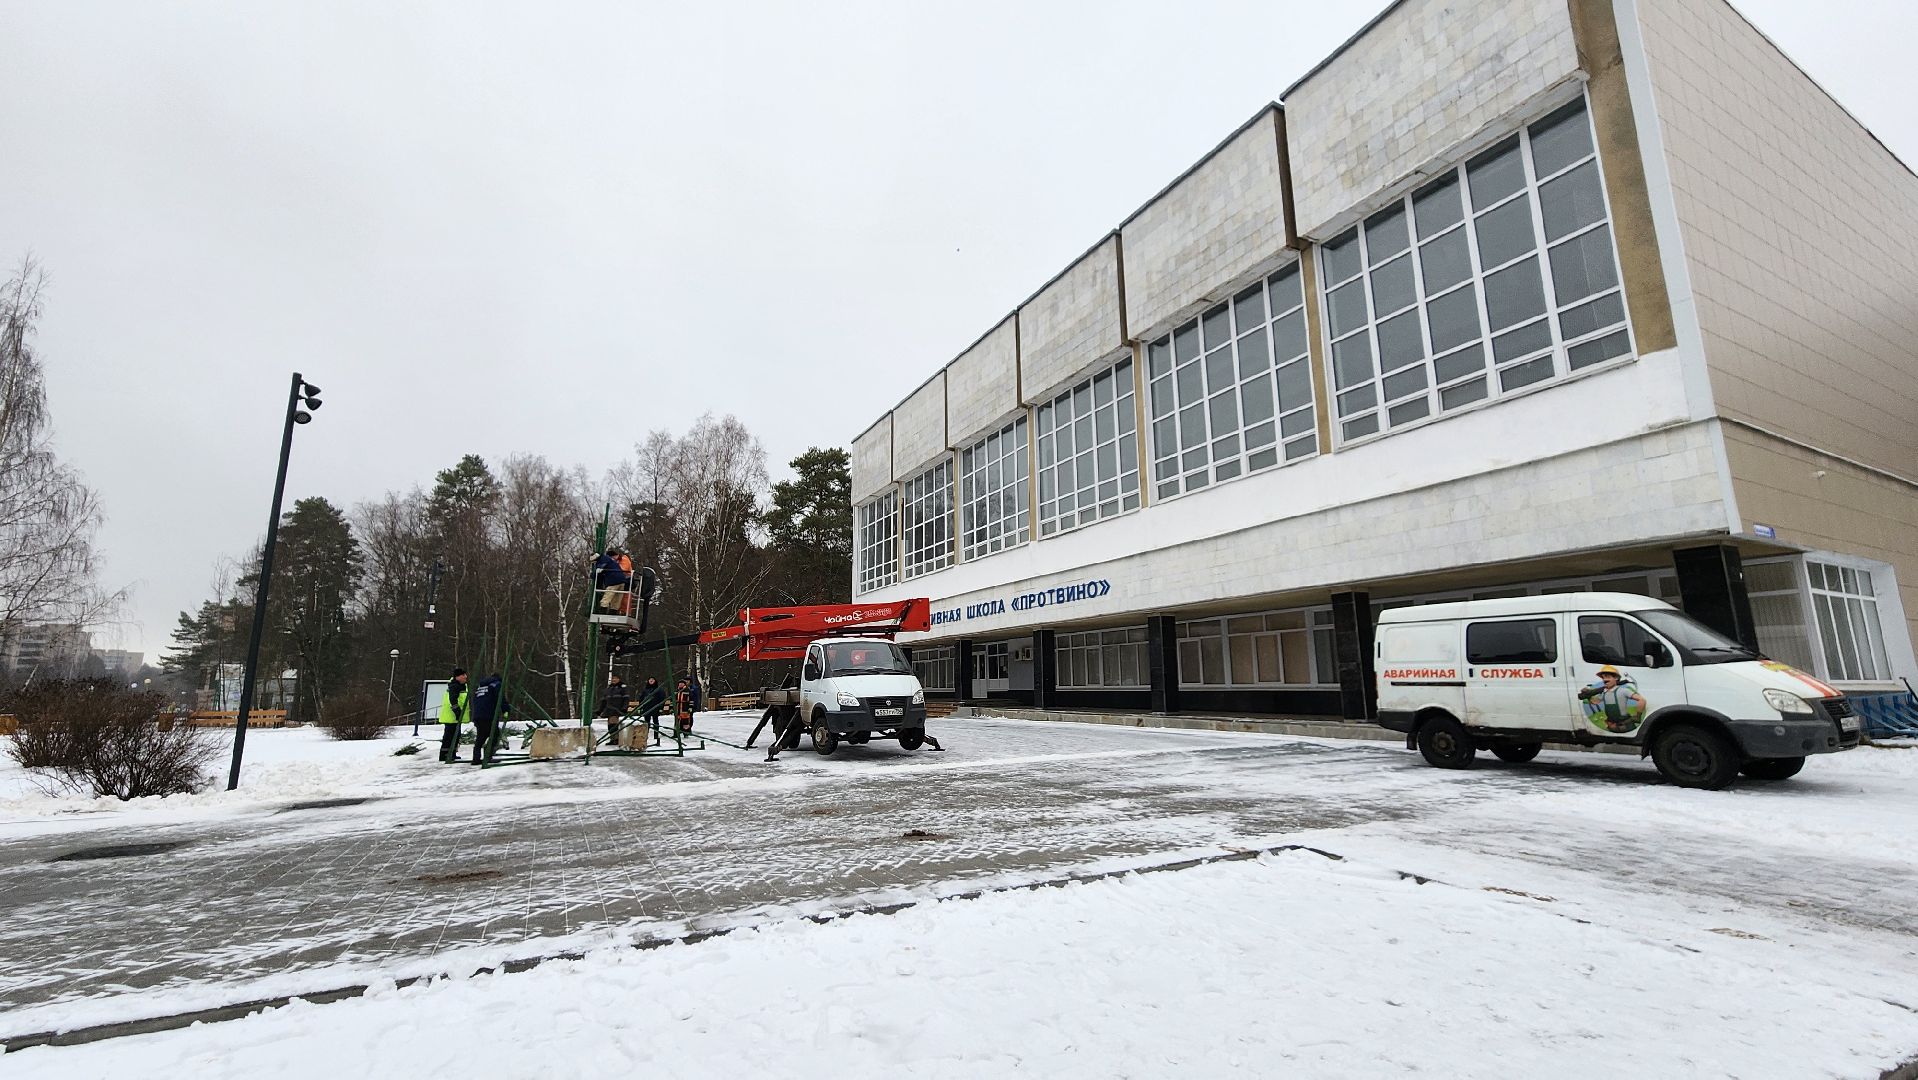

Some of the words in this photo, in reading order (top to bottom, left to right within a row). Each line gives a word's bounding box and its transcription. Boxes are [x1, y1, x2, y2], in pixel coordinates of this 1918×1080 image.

[966, 598, 1006, 619] ШКОЛА
[1010, 579, 1111, 612] «ПРОТВИНО»
[1383, 667, 1456, 679] АВАРИЙНАЯ
[1480, 668, 1544, 679] СЛУЖБА
